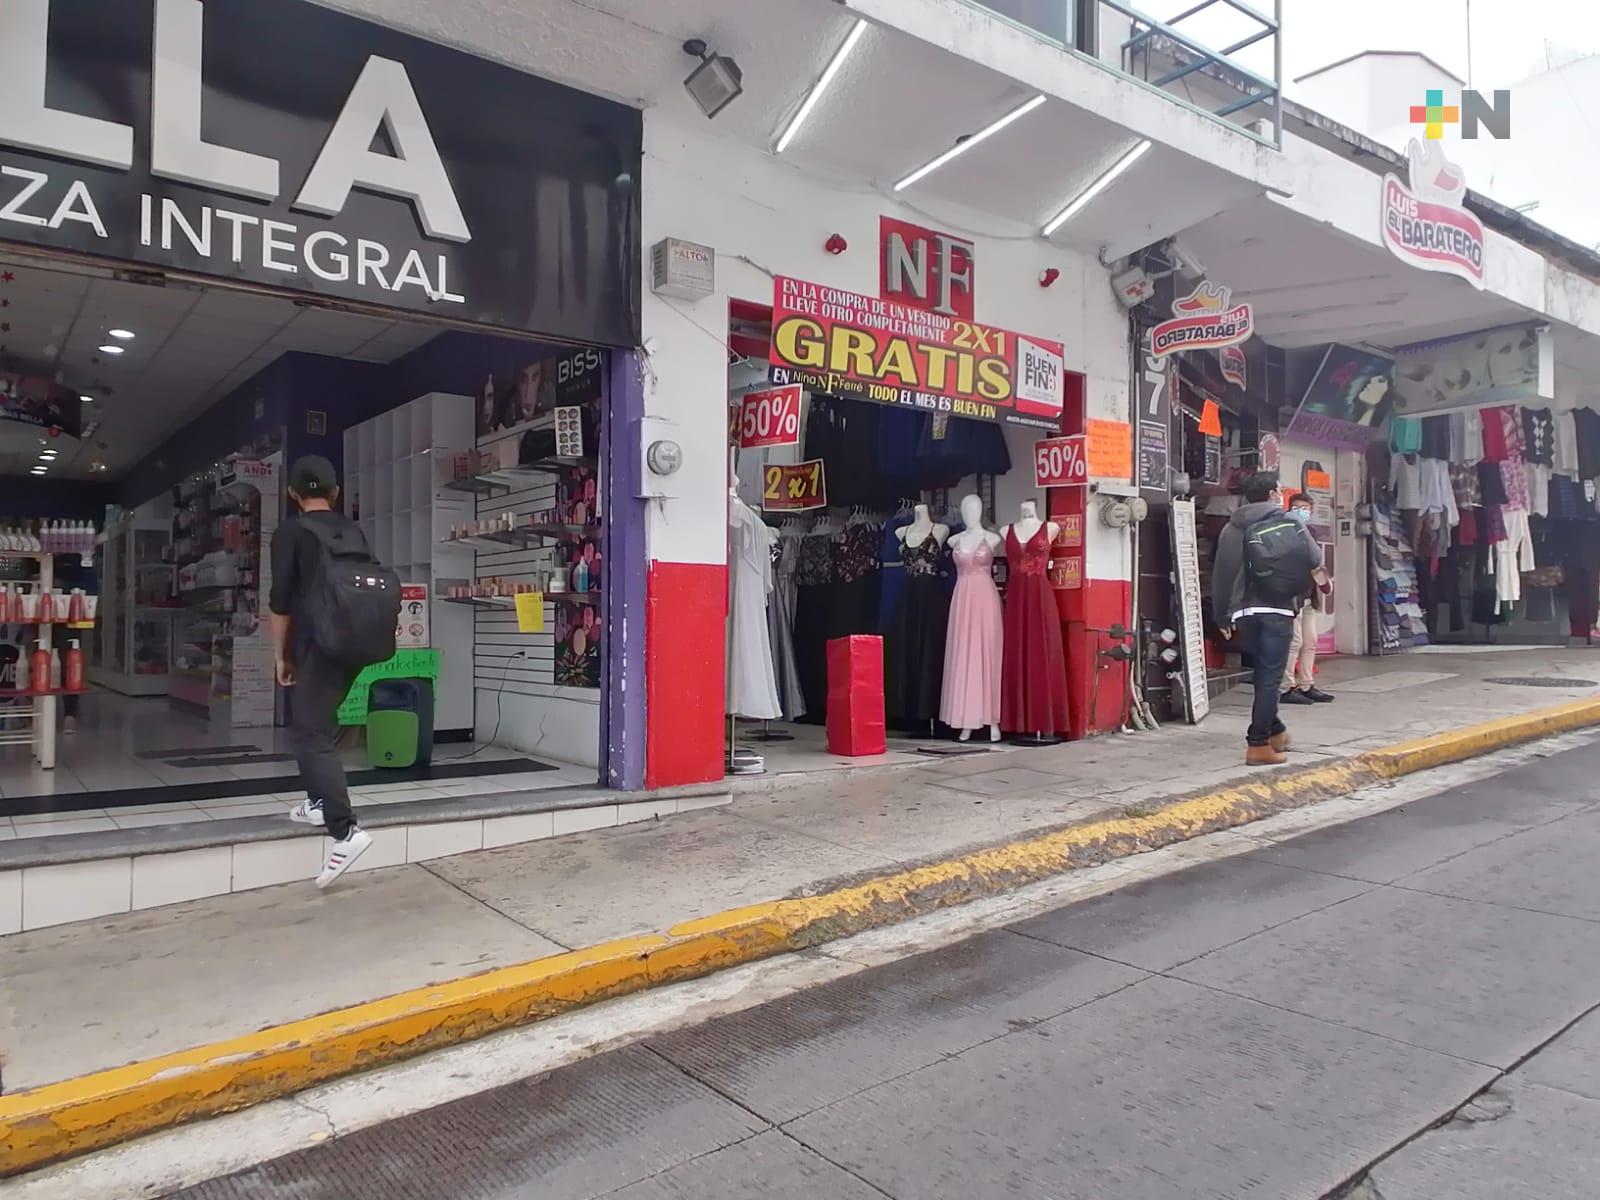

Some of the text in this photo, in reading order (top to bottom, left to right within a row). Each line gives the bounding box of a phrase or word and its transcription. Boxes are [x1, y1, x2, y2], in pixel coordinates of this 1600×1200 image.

[1390, 188, 1418, 217] LUIS
[0, 165, 466, 304] ZA INTEGRAL
[1389, 211, 1482, 267] EL BARATERO
[782, 294, 947, 344] LLEVE OTRO COMPLETAMENTE
[783, 279, 951, 331] EN LA COMPRA DE UN VESTIDO
[775, 318, 1012, 400] GRATIS
[953, 320, 1006, 357] 2X1
[1025, 353, 1057, 377] BUEN
[743, 395, 797, 438] 50%
[773, 368, 790, 384] EN
[793, 372, 817, 385] Nina
[869, 384, 898, 402] TODO
[900, 390, 913, 405] EL
[915, 393, 936, 409] MES
[939, 397, 951, 411] ES
[953, 400, 979, 416] BUEN
[981, 404, 997, 419] FIN
[1037, 442, 1085, 479] 50%
